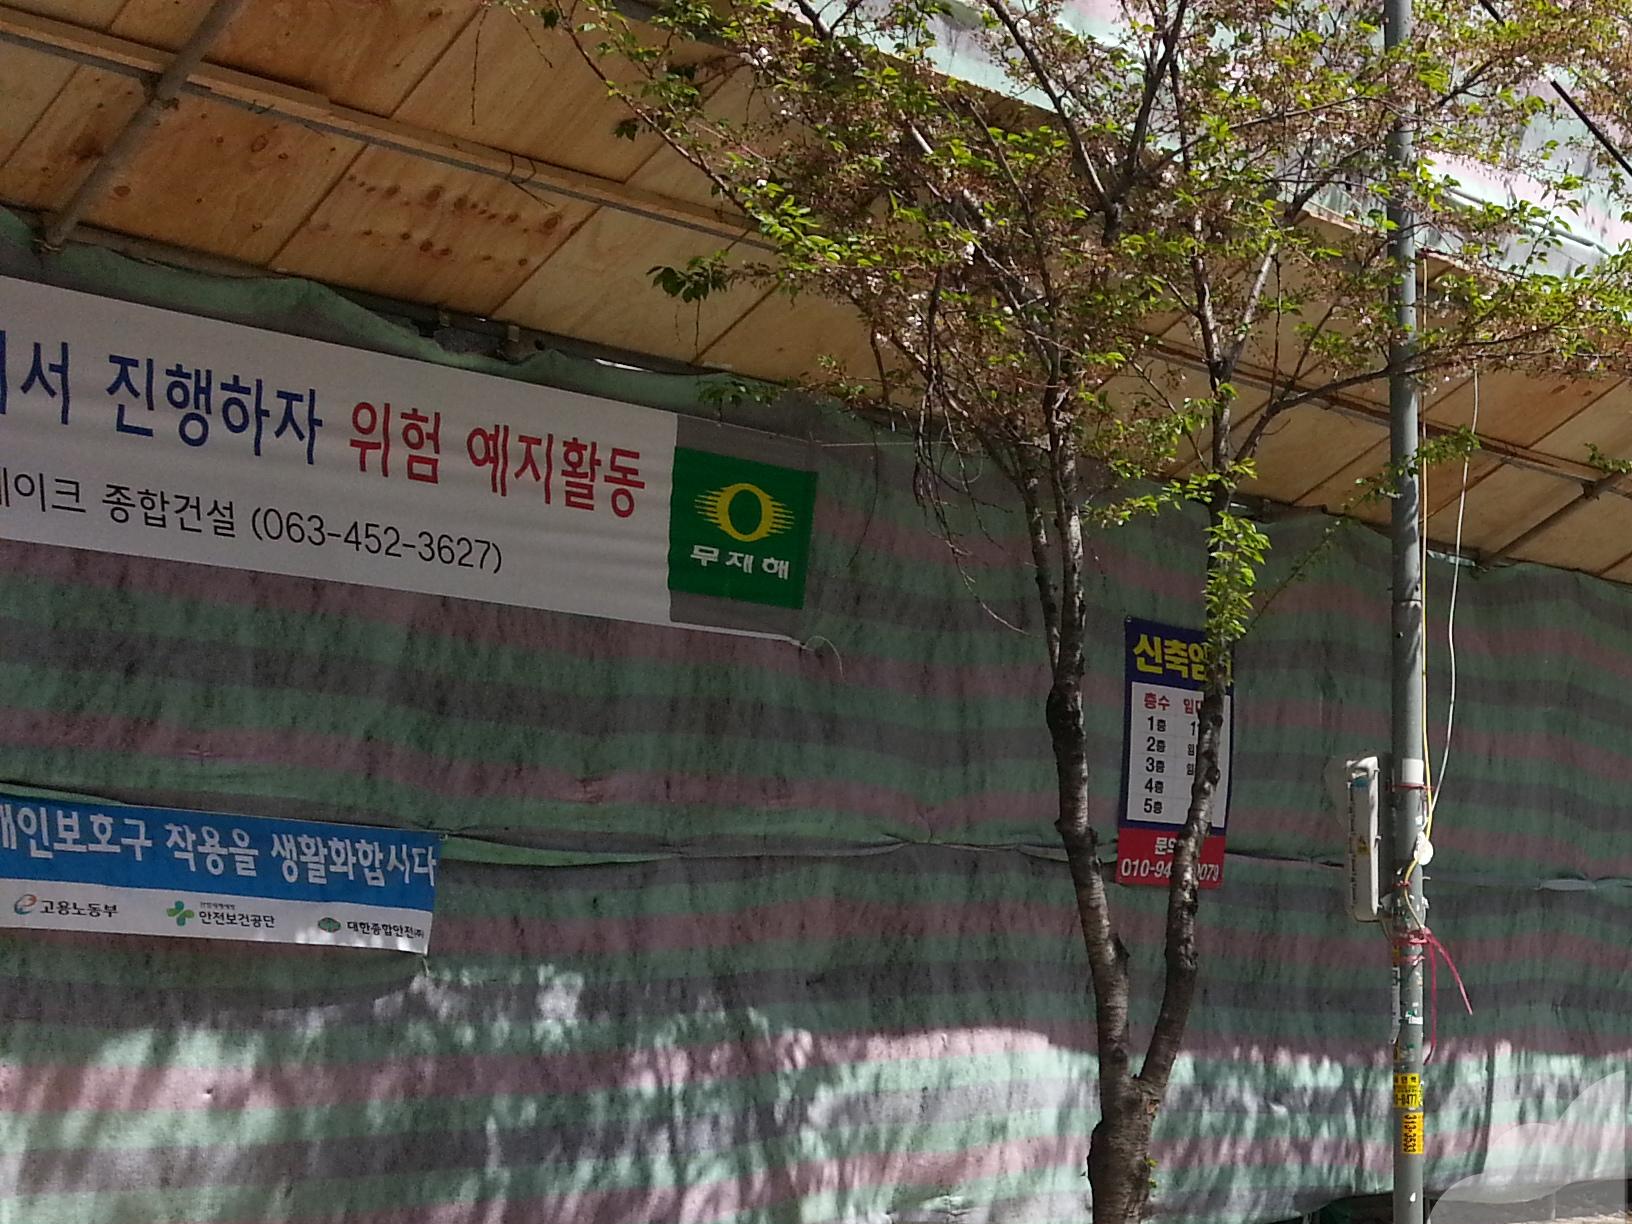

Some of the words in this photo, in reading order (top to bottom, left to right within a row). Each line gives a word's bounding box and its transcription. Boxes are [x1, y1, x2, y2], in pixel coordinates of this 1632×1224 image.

[106, 354, 323, 465] 진행하자
[350, 402, 441, 484] 위험
[466, 424, 645, 518] 예지활동
[102, 483, 236, 538] 종합건설
[252, 507, 502, 574] (063-452-3627)
[690, 544, 790, 580] 무재해
[1133, 633, 1232, 682] 신축임
[1144, 692, 1170, 711] 층수
[164, 823, 259, 877] 착용을
[271, 833, 436, 887] 생활화합시다
[40, 900, 119, 918] 고용노동부
[199, 911, 275, 929] 안전보건공단
